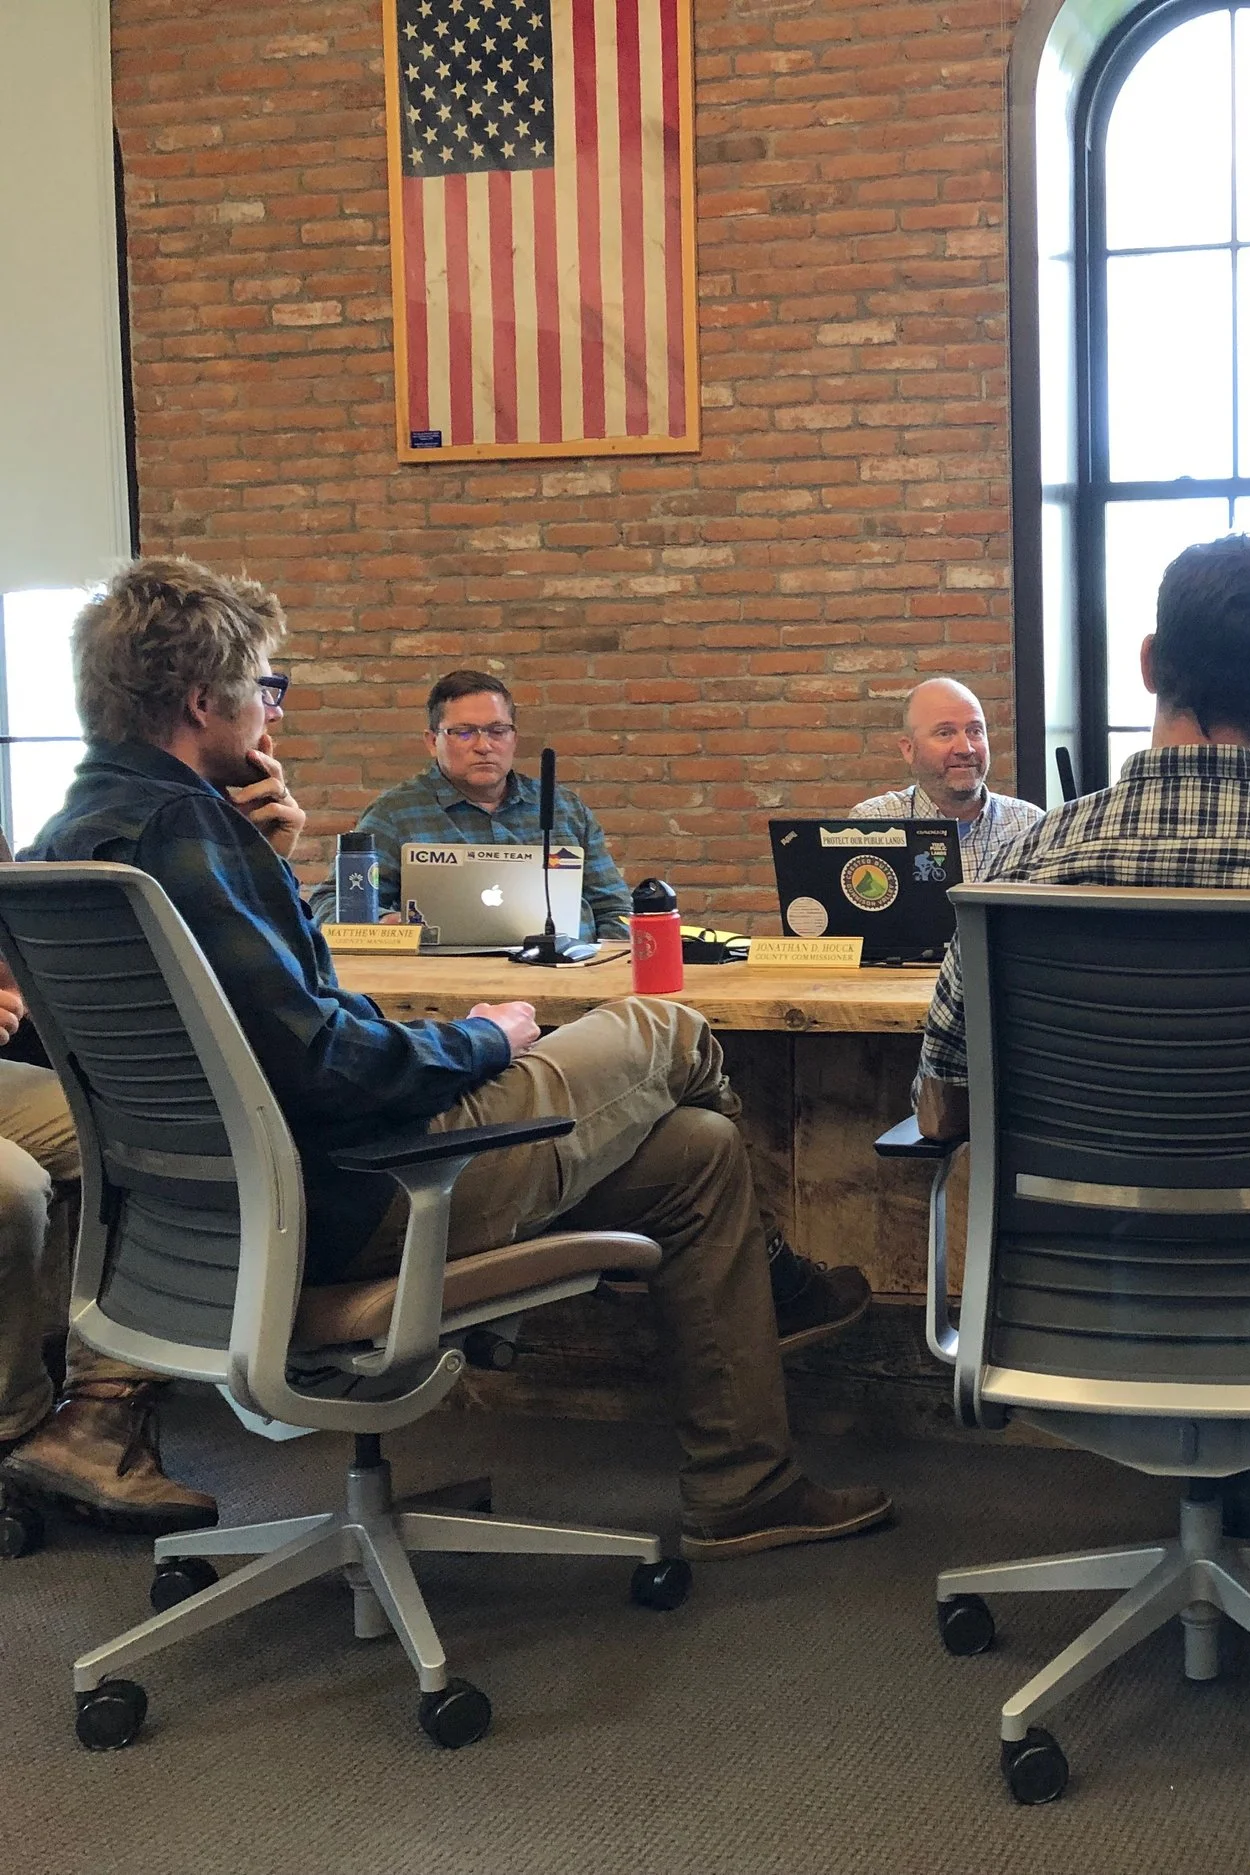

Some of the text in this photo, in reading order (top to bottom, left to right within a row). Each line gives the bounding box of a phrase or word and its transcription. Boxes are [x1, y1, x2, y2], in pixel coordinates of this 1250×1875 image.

[823, 837, 906, 845] PROTECT OUR PUBLIC LANDS
[410, 850, 458, 864] ICMA
[477, 851, 533, 860] ONE TEAM
[328, 928, 415, 938] MATTHEW BIRNIE
[756, 943, 855, 953] JONATHAN D. HOUCK
[754, 953, 789, 961] COUNTY
